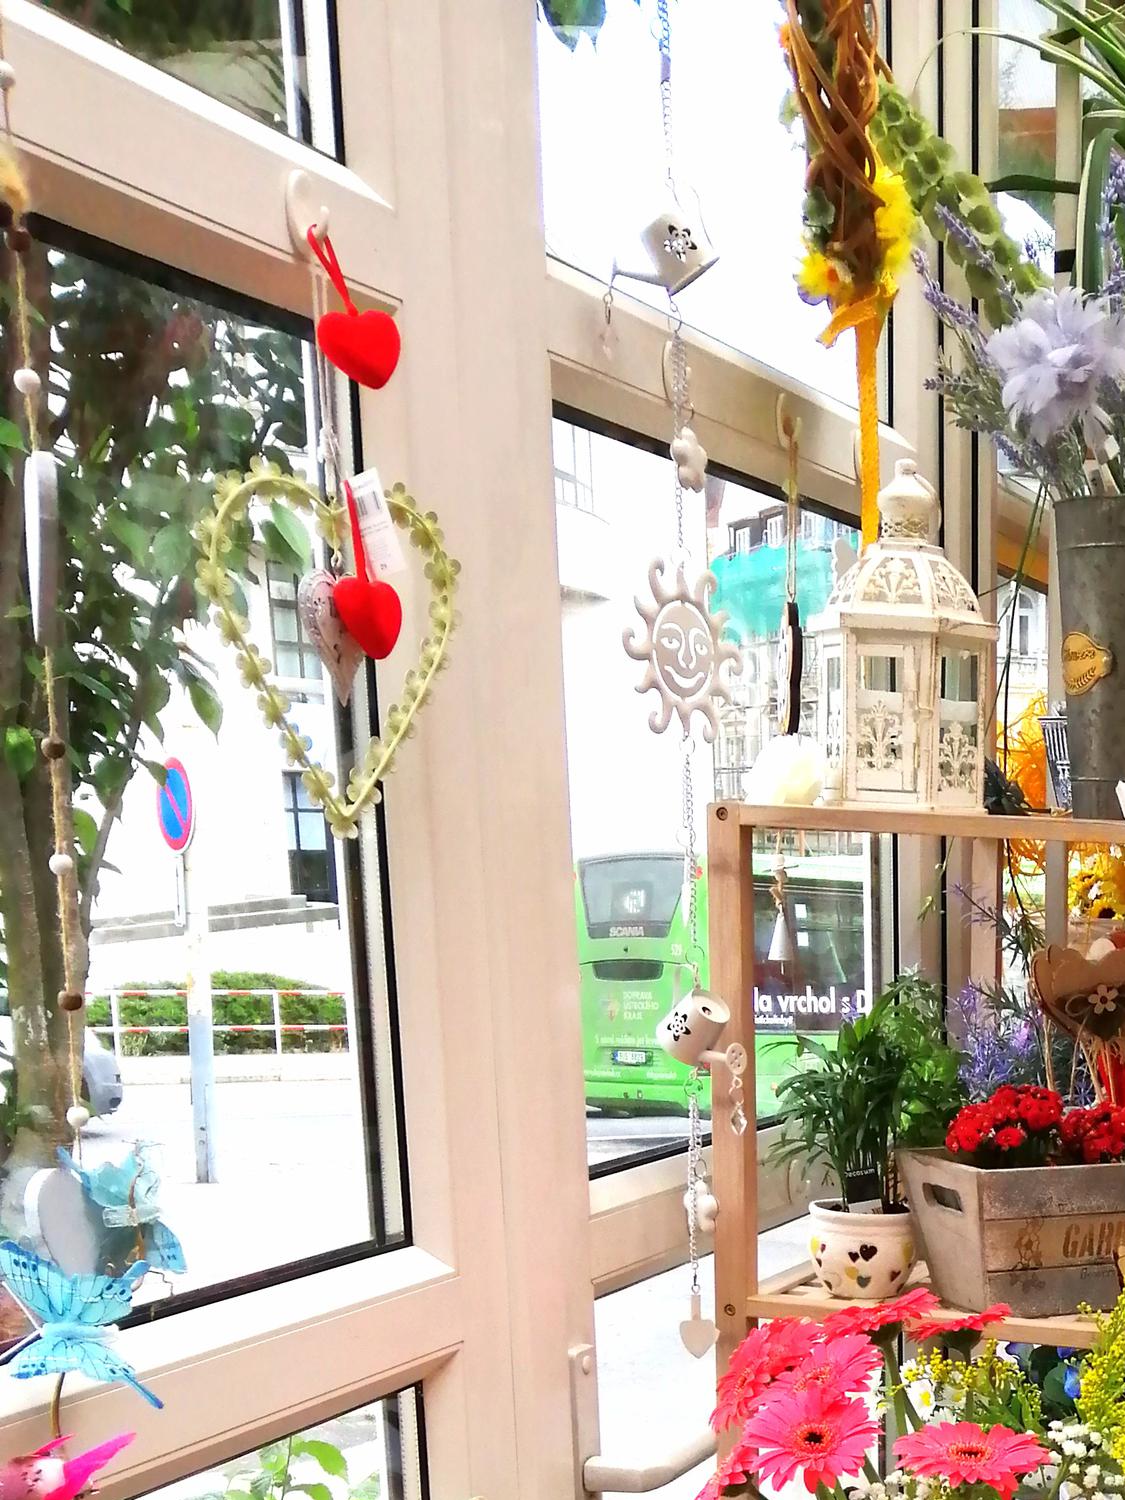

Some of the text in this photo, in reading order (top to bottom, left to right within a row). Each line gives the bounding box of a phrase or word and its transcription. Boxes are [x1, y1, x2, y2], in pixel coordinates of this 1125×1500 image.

[609, 926, 645, 937] SCANIA
[777, 985, 836, 1013] vrchol
[841, 996, 851, 1013] s
